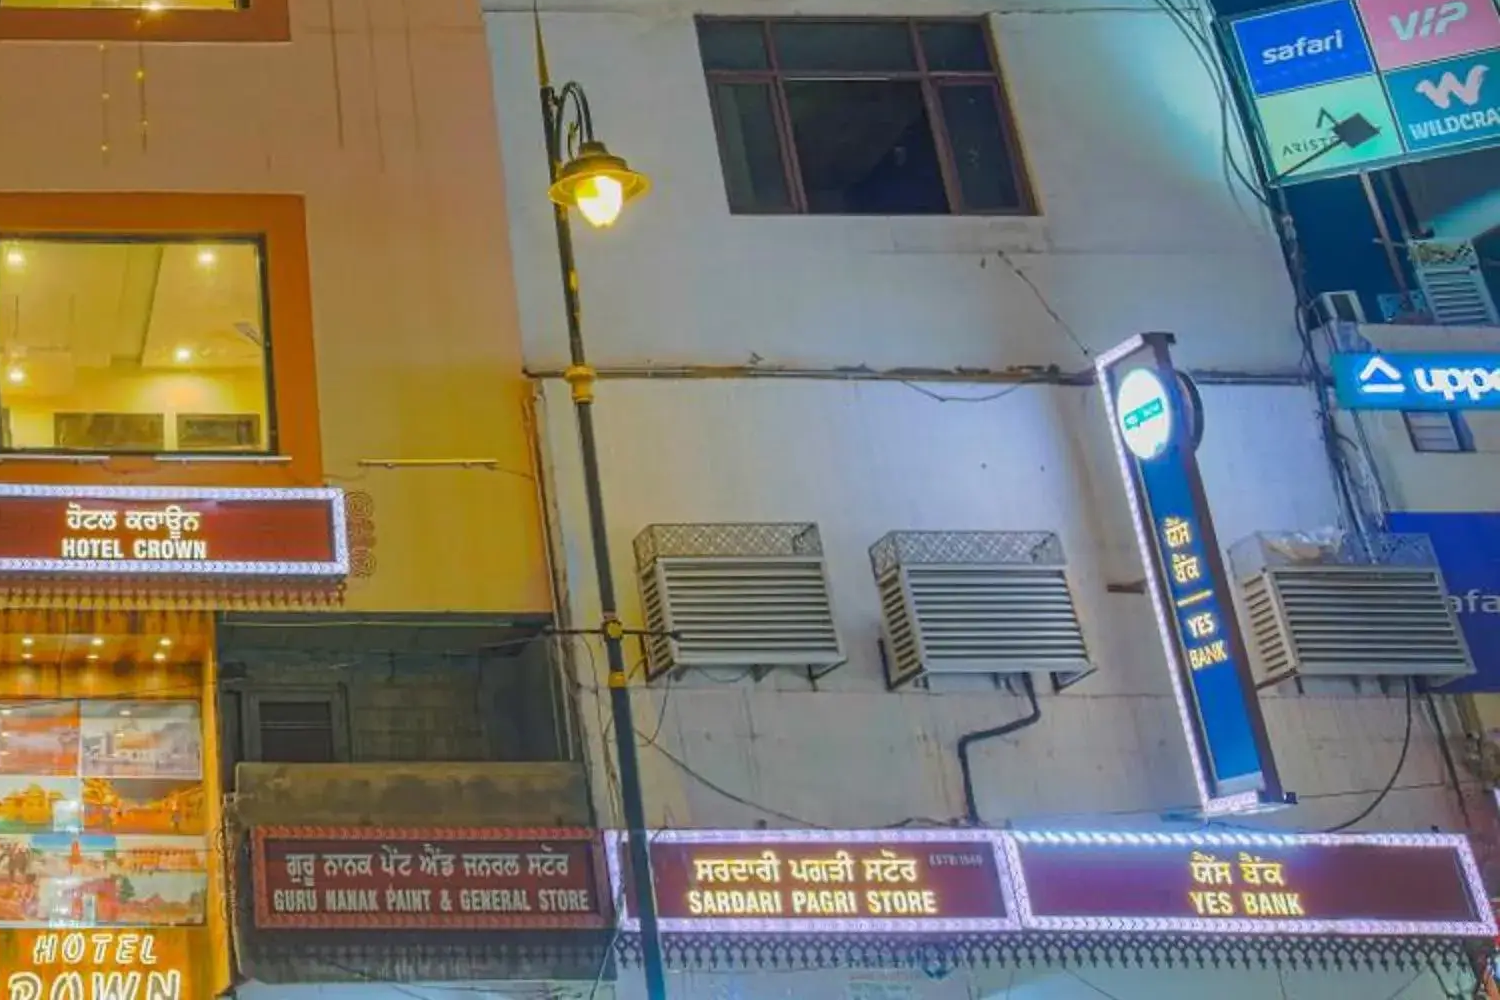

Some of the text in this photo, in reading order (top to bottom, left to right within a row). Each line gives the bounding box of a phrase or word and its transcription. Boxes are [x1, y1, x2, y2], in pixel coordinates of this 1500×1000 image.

[1389, 2, 1467, 40] VIP
[1262, 29, 1343, 65] safari
[1408, 106, 1500, 139] WILDCRA
[66, 501, 202, 539] ਹੋਟਲ ਕਰਾਊਨ
[61, 537, 207, 559] HOTEL CROWN
[1187, 612, 1215, 638] YES
[1188, 640, 1228, 670] BANK
[285, 853, 316, 887] ਗੁਰੂ
[322, 853, 373, 877] ਨਾਨਕ
[462, 853, 520, 877] ਜਨਰਲ
[526, 844, 570, 877] ਸਟੋਰ
[693, 849, 918, 882] ਸਰਦਾਰੀ ਪਗੜੀ ਸਟੋਰ
[1238, 851, 1285, 886] ਬੈਂਕ
[274, 888, 590, 912] GURU NANAK PAINT & GENERAL STORE
[688, 890, 938, 914] SARDARI PAGRI STORE
[1188, 891, 1305, 916] YES BANK
[33, 933, 157, 964] HOTEL
